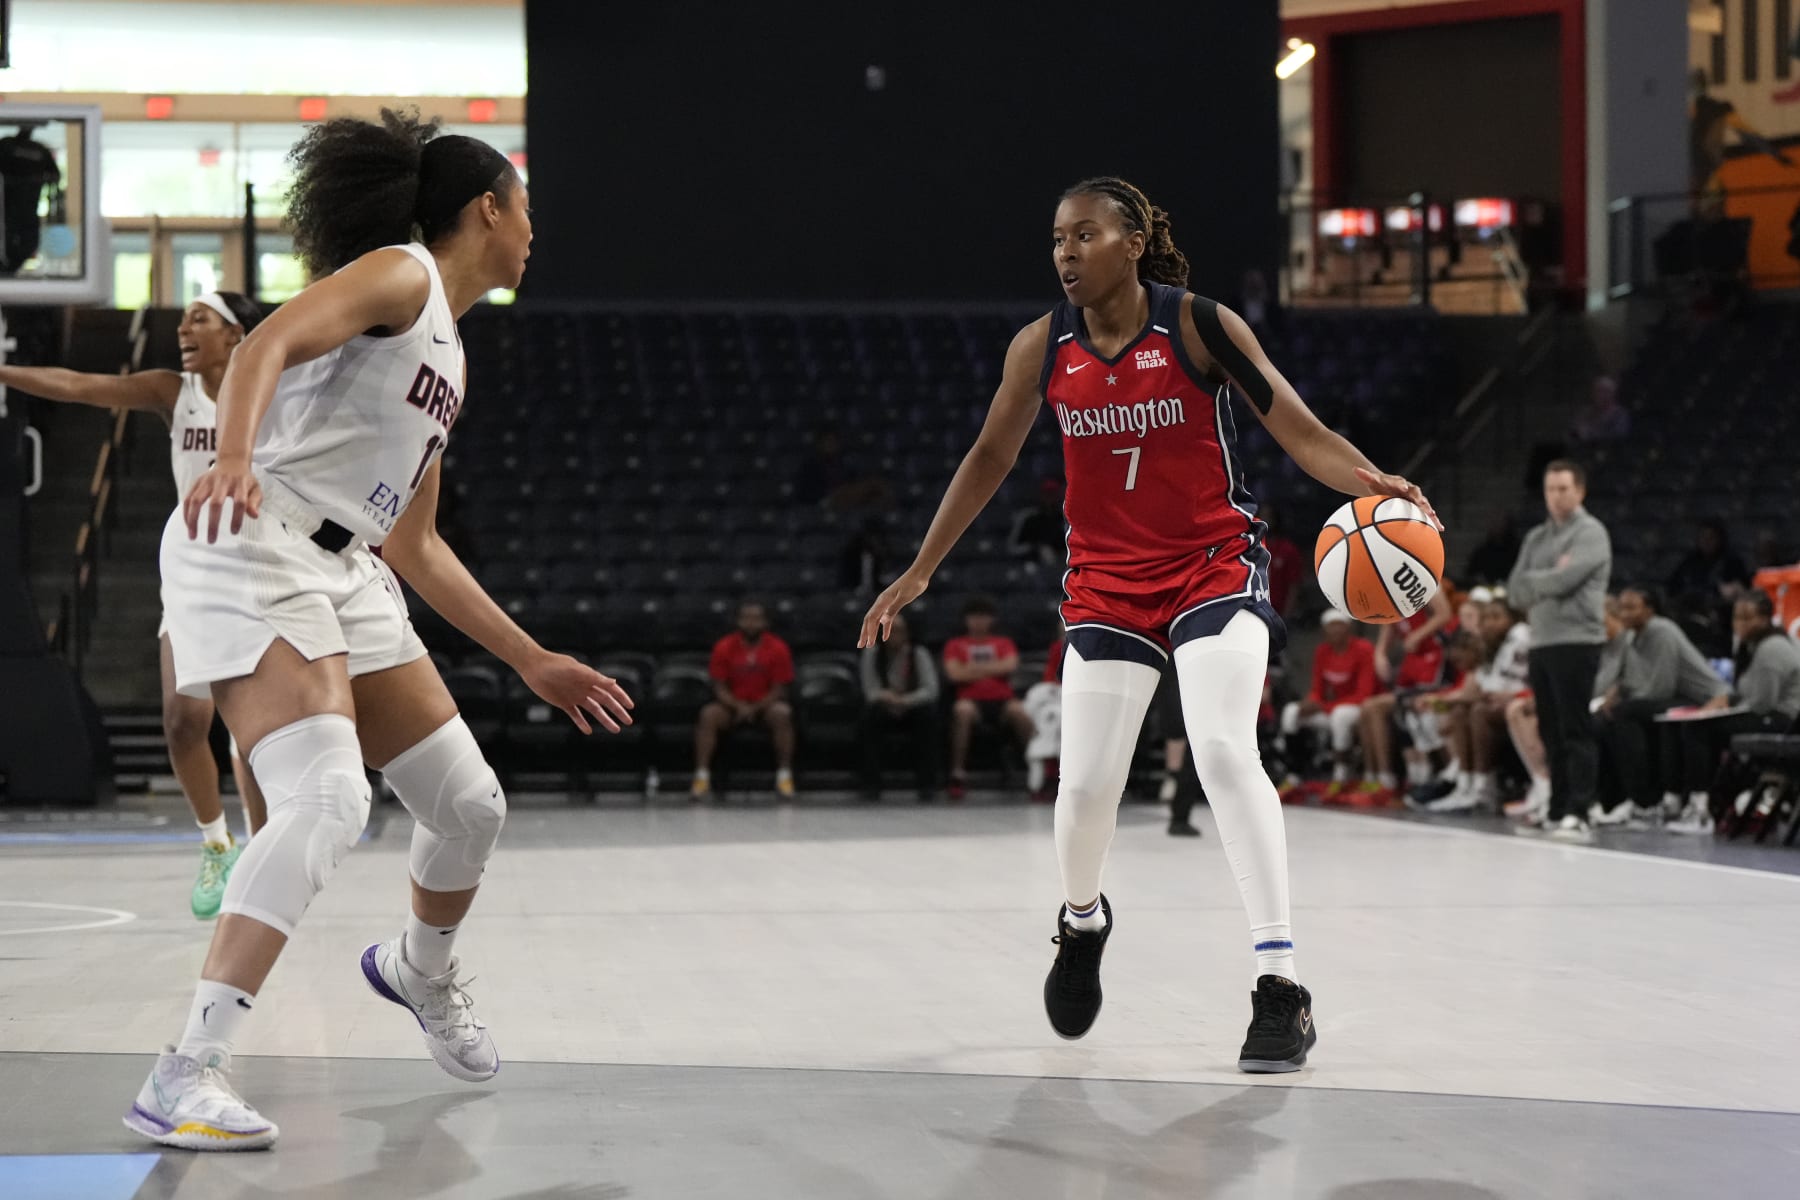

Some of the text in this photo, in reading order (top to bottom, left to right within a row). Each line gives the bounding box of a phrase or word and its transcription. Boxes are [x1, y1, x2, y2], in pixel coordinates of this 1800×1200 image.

[1135, 349, 1160, 360] CAR
[1136, 357, 1168, 369] max
[1056, 398, 1185, 438] Washington
[1111, 446, 1141, 490] 7
